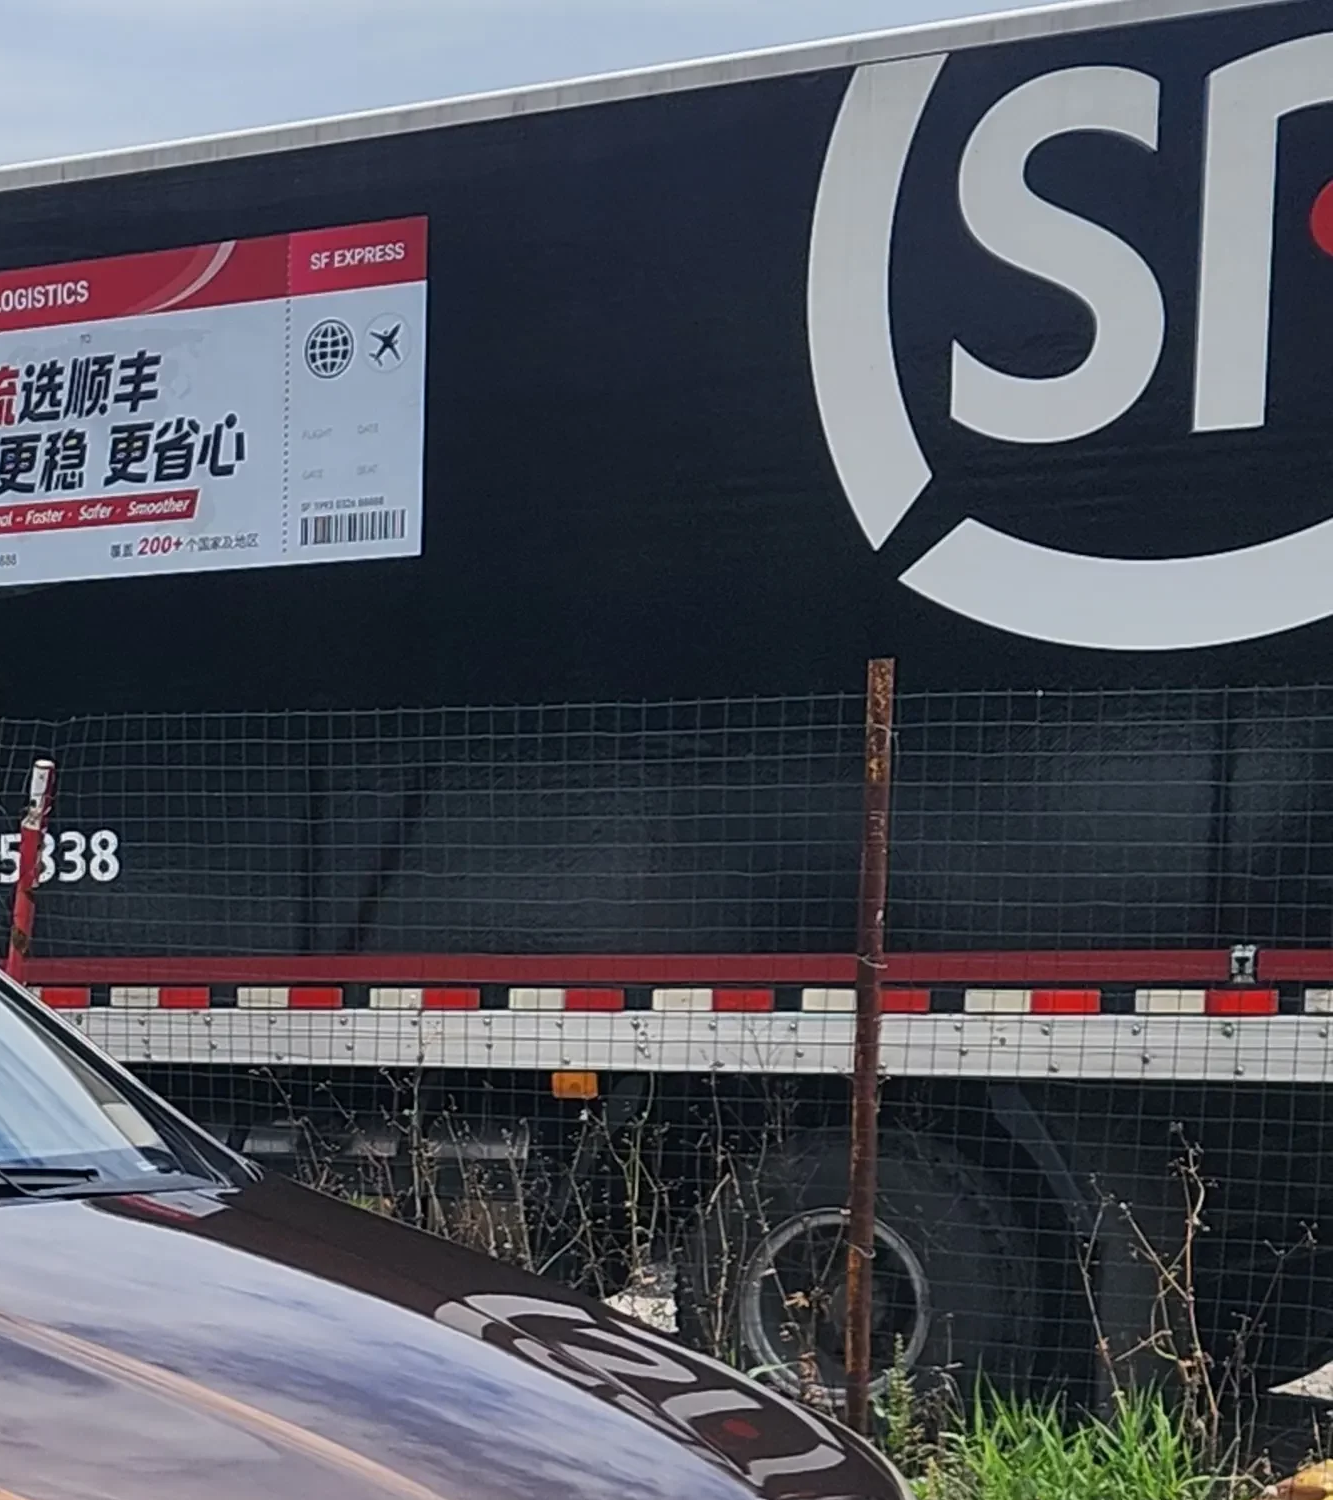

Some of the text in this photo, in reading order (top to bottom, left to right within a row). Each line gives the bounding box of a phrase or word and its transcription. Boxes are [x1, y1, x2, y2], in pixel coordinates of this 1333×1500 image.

[310, 242, 405, 270] SF EXPRESS
[103, 413, 246, 487] 更省心
[24, 509, 65, 526] Faster
[77, 504, 111, 522] Safer
[126, 498, 191, 517] Smoother
